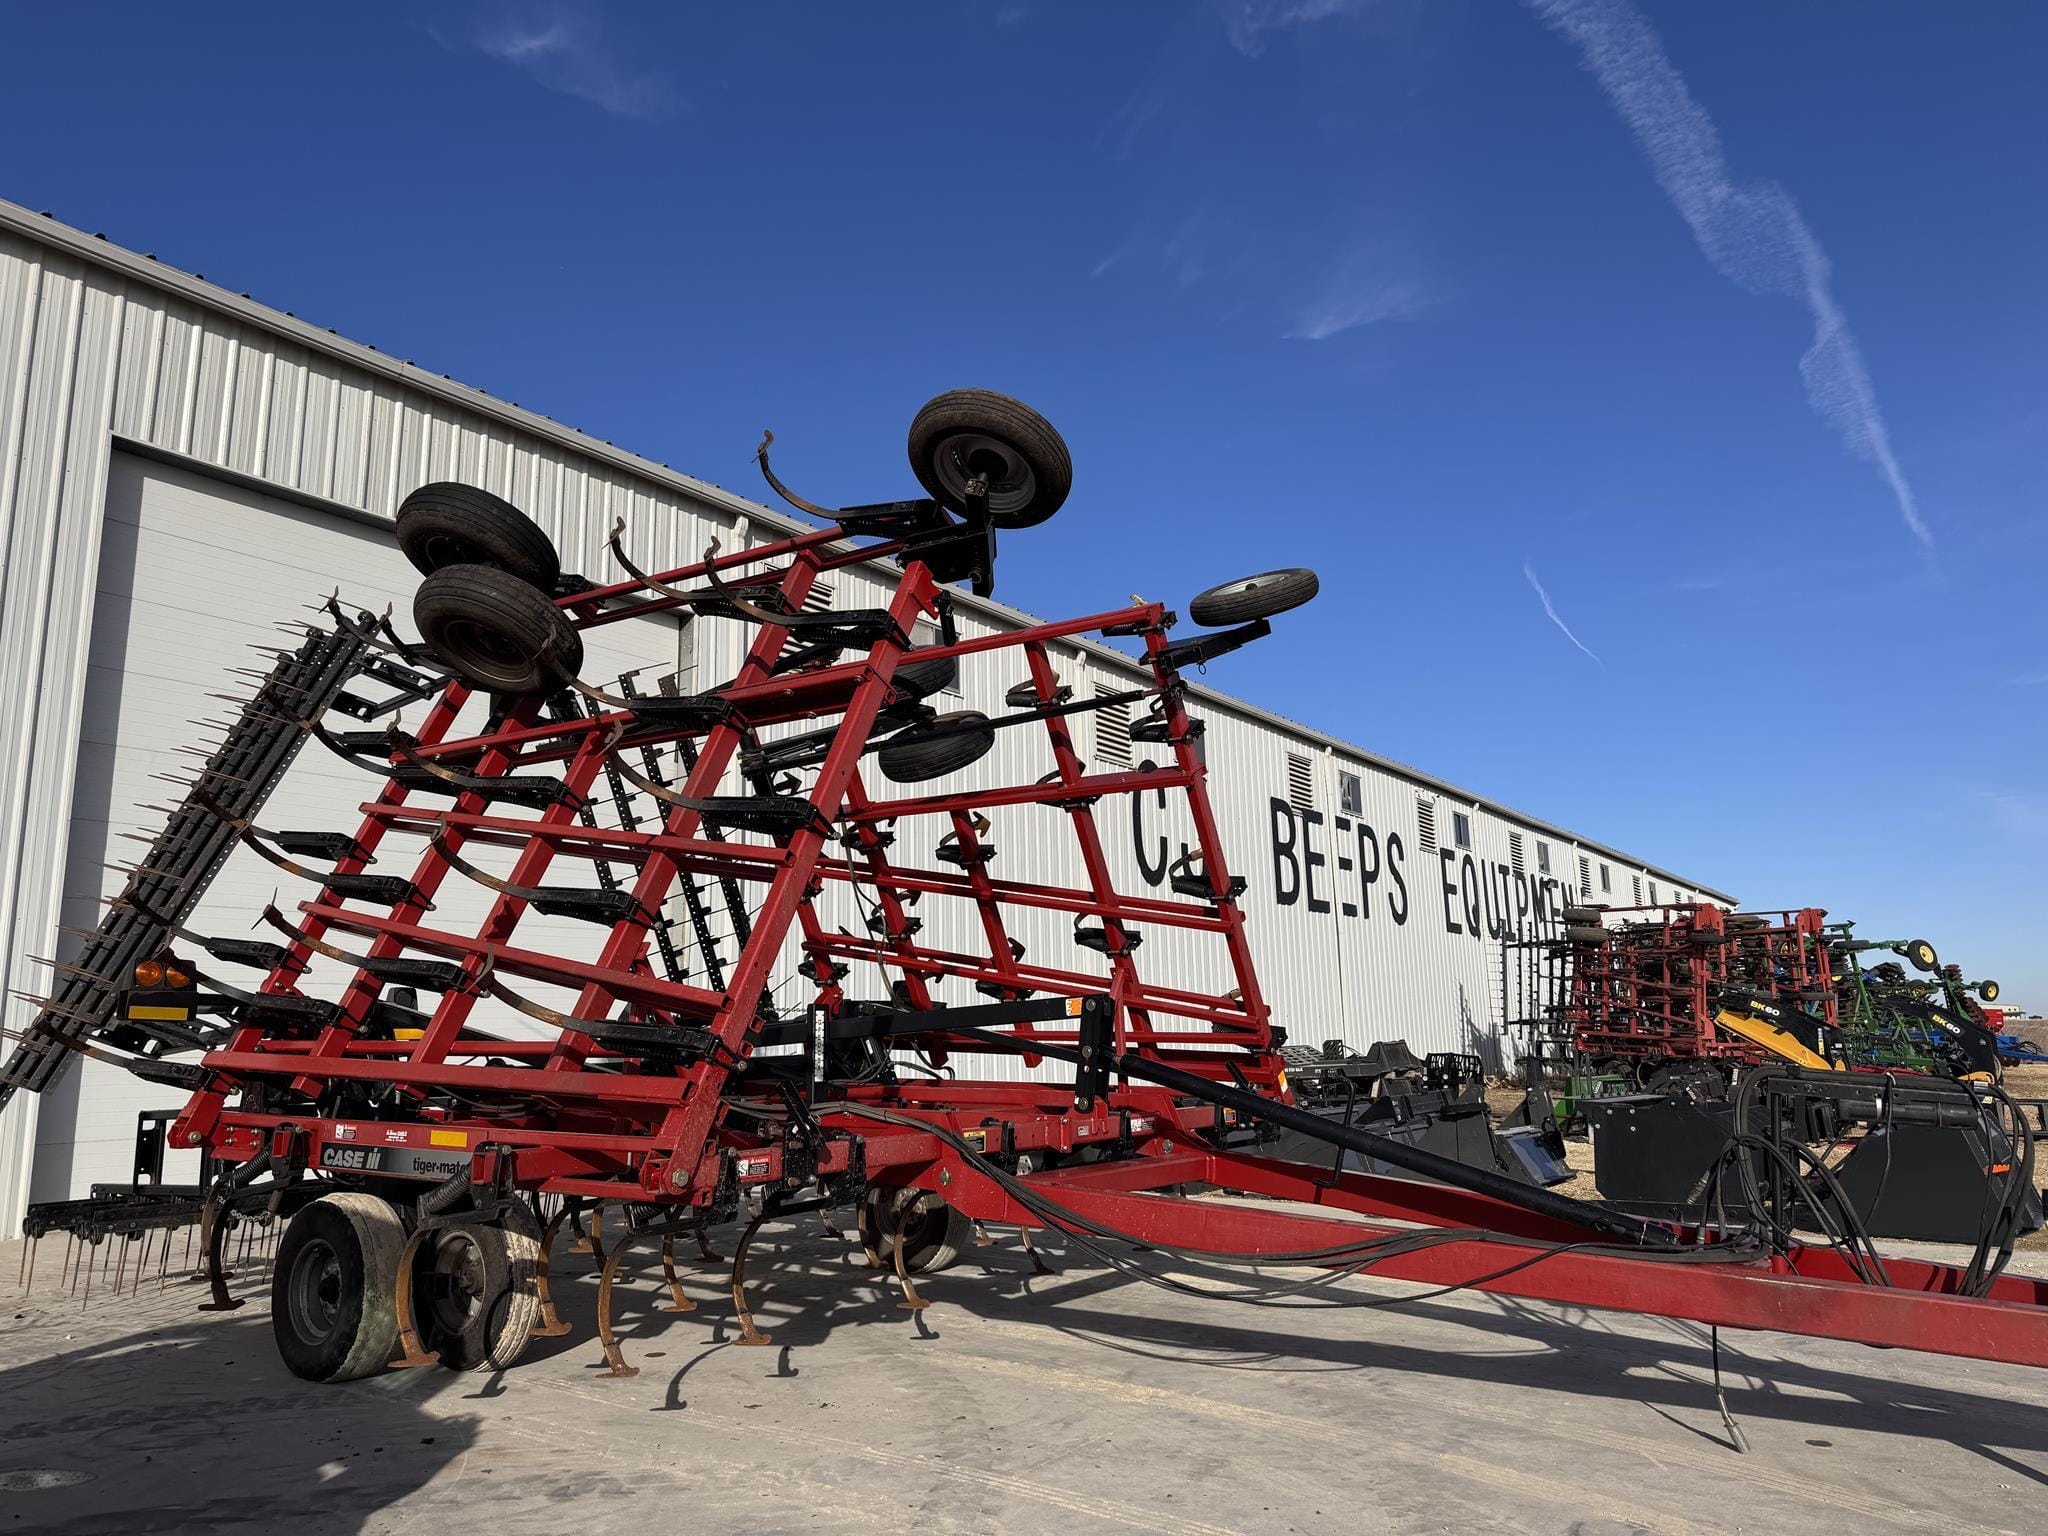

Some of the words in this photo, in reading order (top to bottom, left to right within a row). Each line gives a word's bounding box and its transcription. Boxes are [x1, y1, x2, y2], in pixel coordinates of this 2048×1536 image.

[1270, 797, 1408, 925] BEEPS
[1440, 848, 1587, 942] EQUIPME
[323, 1148, 364, 1167] CASE
